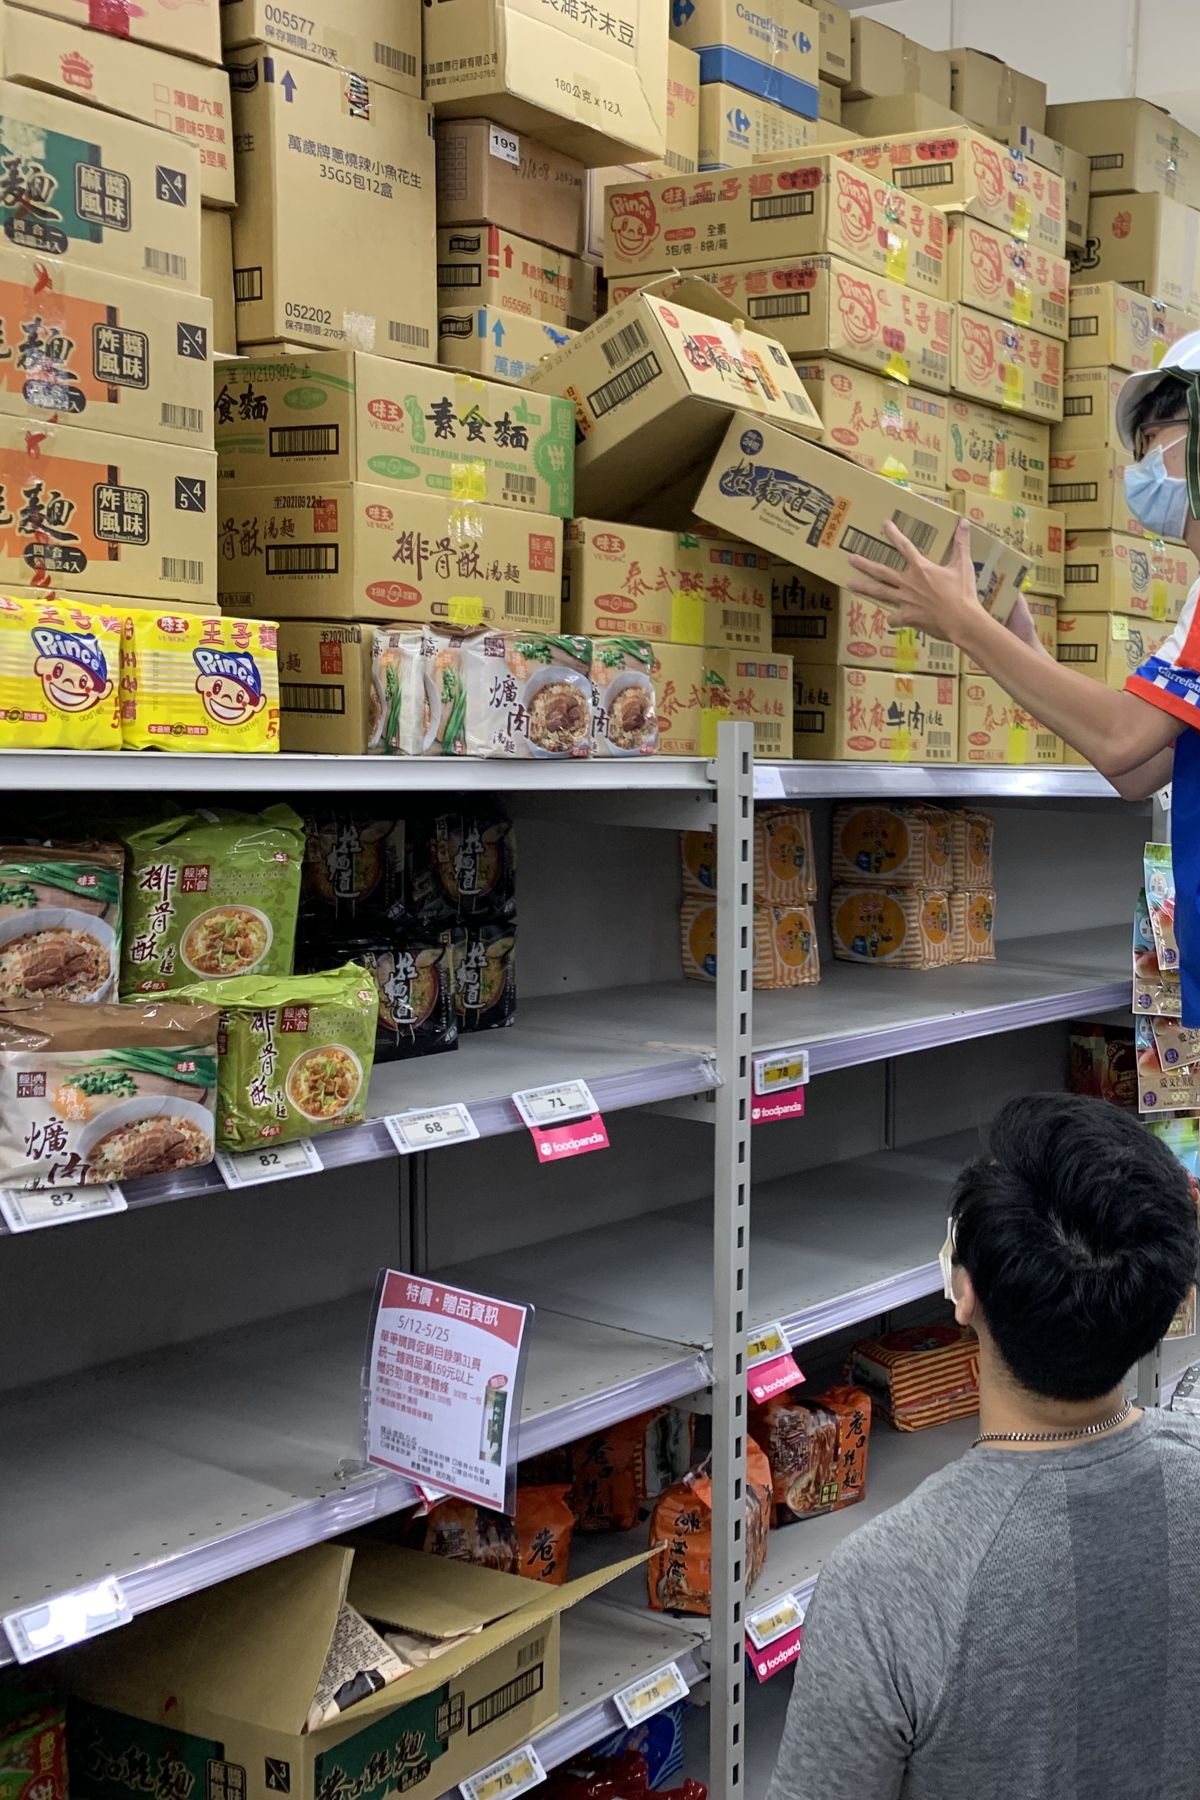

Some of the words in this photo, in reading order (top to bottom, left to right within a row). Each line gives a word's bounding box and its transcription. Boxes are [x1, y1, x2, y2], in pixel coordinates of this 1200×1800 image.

[264, 4, 316, 37] 005577
[735, 3, 789, 39] Carrefour
[264, 26, 339, 63] 保存期限:270天
[554, 77, 593, 105] 180公克
[493, 135, 517, 153] 199
[161, 183, 170, 200] 5
[173, 174, 182, 190] 4
[319, 163, 394, 199] 35G5包12盒
[80, 190, 126, 221] 風味
[611, 196, 652, 219] Prince
[285, 302, 332, 325] 052202
[99, 328, 143, 357] 炸醬
[182, 341, 191, 355] 5
[194, 331, 203, 345] 4
[98, 350, 143, 378] 風味
[371, 402, 401, 420] 味王
[425, 396, 530, 451] 素食麵
[409, 444, 460, 461] VEGETARIAN
[193, 483, 202, 496] 4
[100, 488, 144, 514] 炸醬
[180, 494, 189, 509] 5
[99, 510, 144, 536] 風味
[392, 531, 521, 584] 排骨酥湯麵
[161, 616, 187, 632] 味王
[198, 618, 278, 651] 王子麵
[34, 630, 100, 671] Prince
[195, 650, 256, 687] Prince
[129, 863, 178, 964] 排骨酥
[777, 1066, 789, 1078] 78
[547, 1096, 566, 1109] 71
[761, 1101, 802, 1117] foodpanda
[424, 1121, 443, 1134] 68
[552, 1132, 605, 1154] foodpanda
[260, 1152, 281, 1167] 82
[396, 1315, 450, 1342] 5/12-5/25
[753, 1340, 767, 1353] 78
[767, 1641, 801, 1671] foodpand
[645, 1688, 660, 1701] 78
[268, 1774, 278, 1788] 4
[279, 1763, 287, 1778] 3
